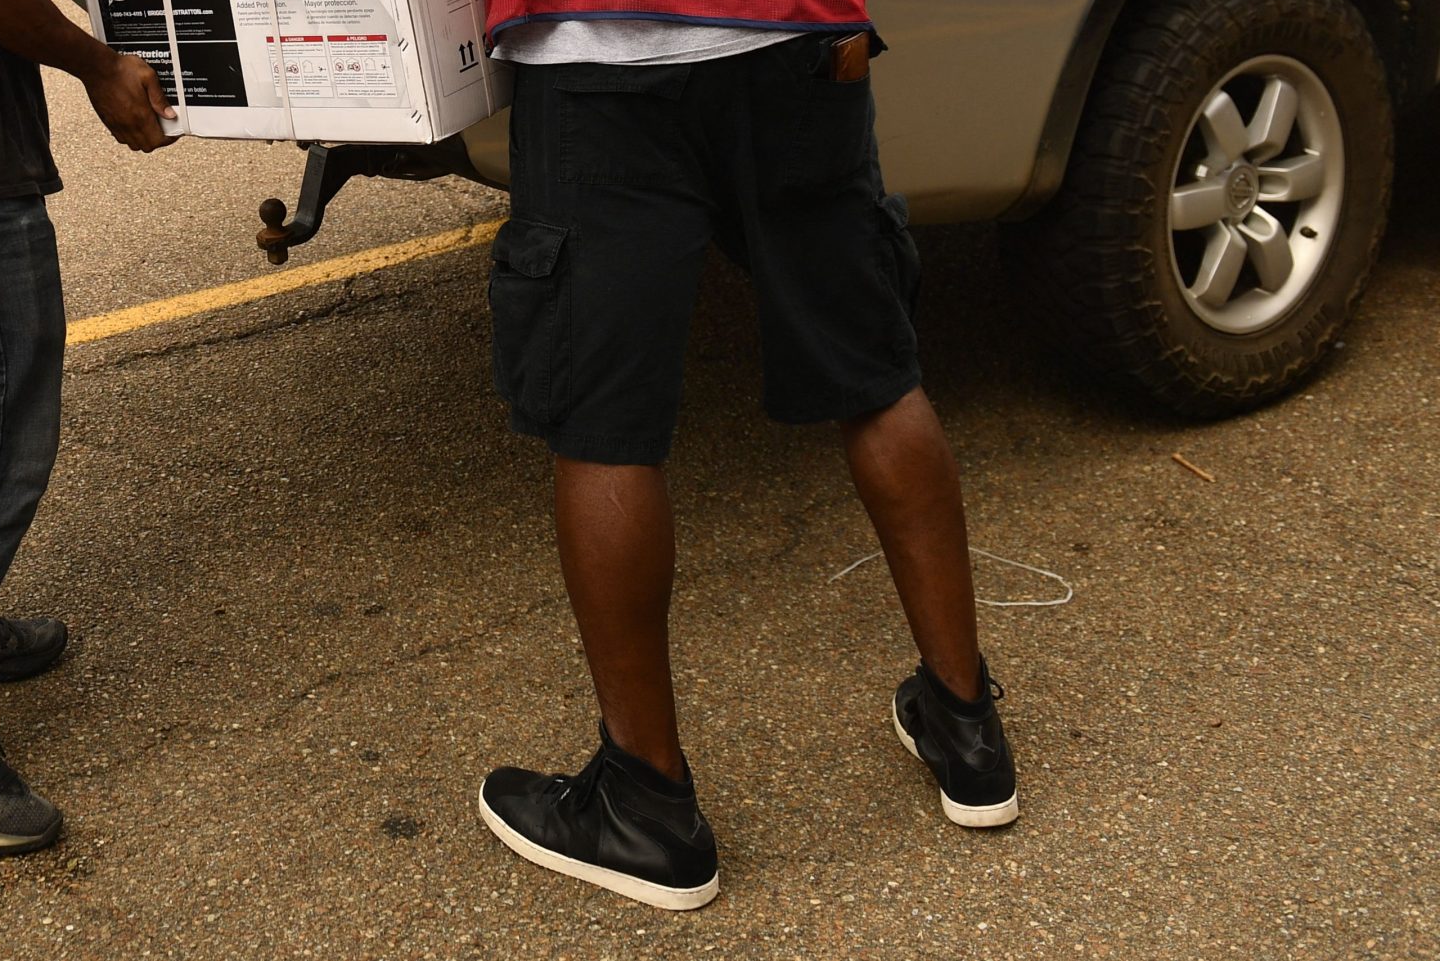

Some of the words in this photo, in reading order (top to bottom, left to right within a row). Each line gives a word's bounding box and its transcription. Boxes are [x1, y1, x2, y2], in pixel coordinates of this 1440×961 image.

[236, 1, 256, 9] Added
[304, 0, 323, 8] Mayor
[324, 0, 358, 7] protección.
